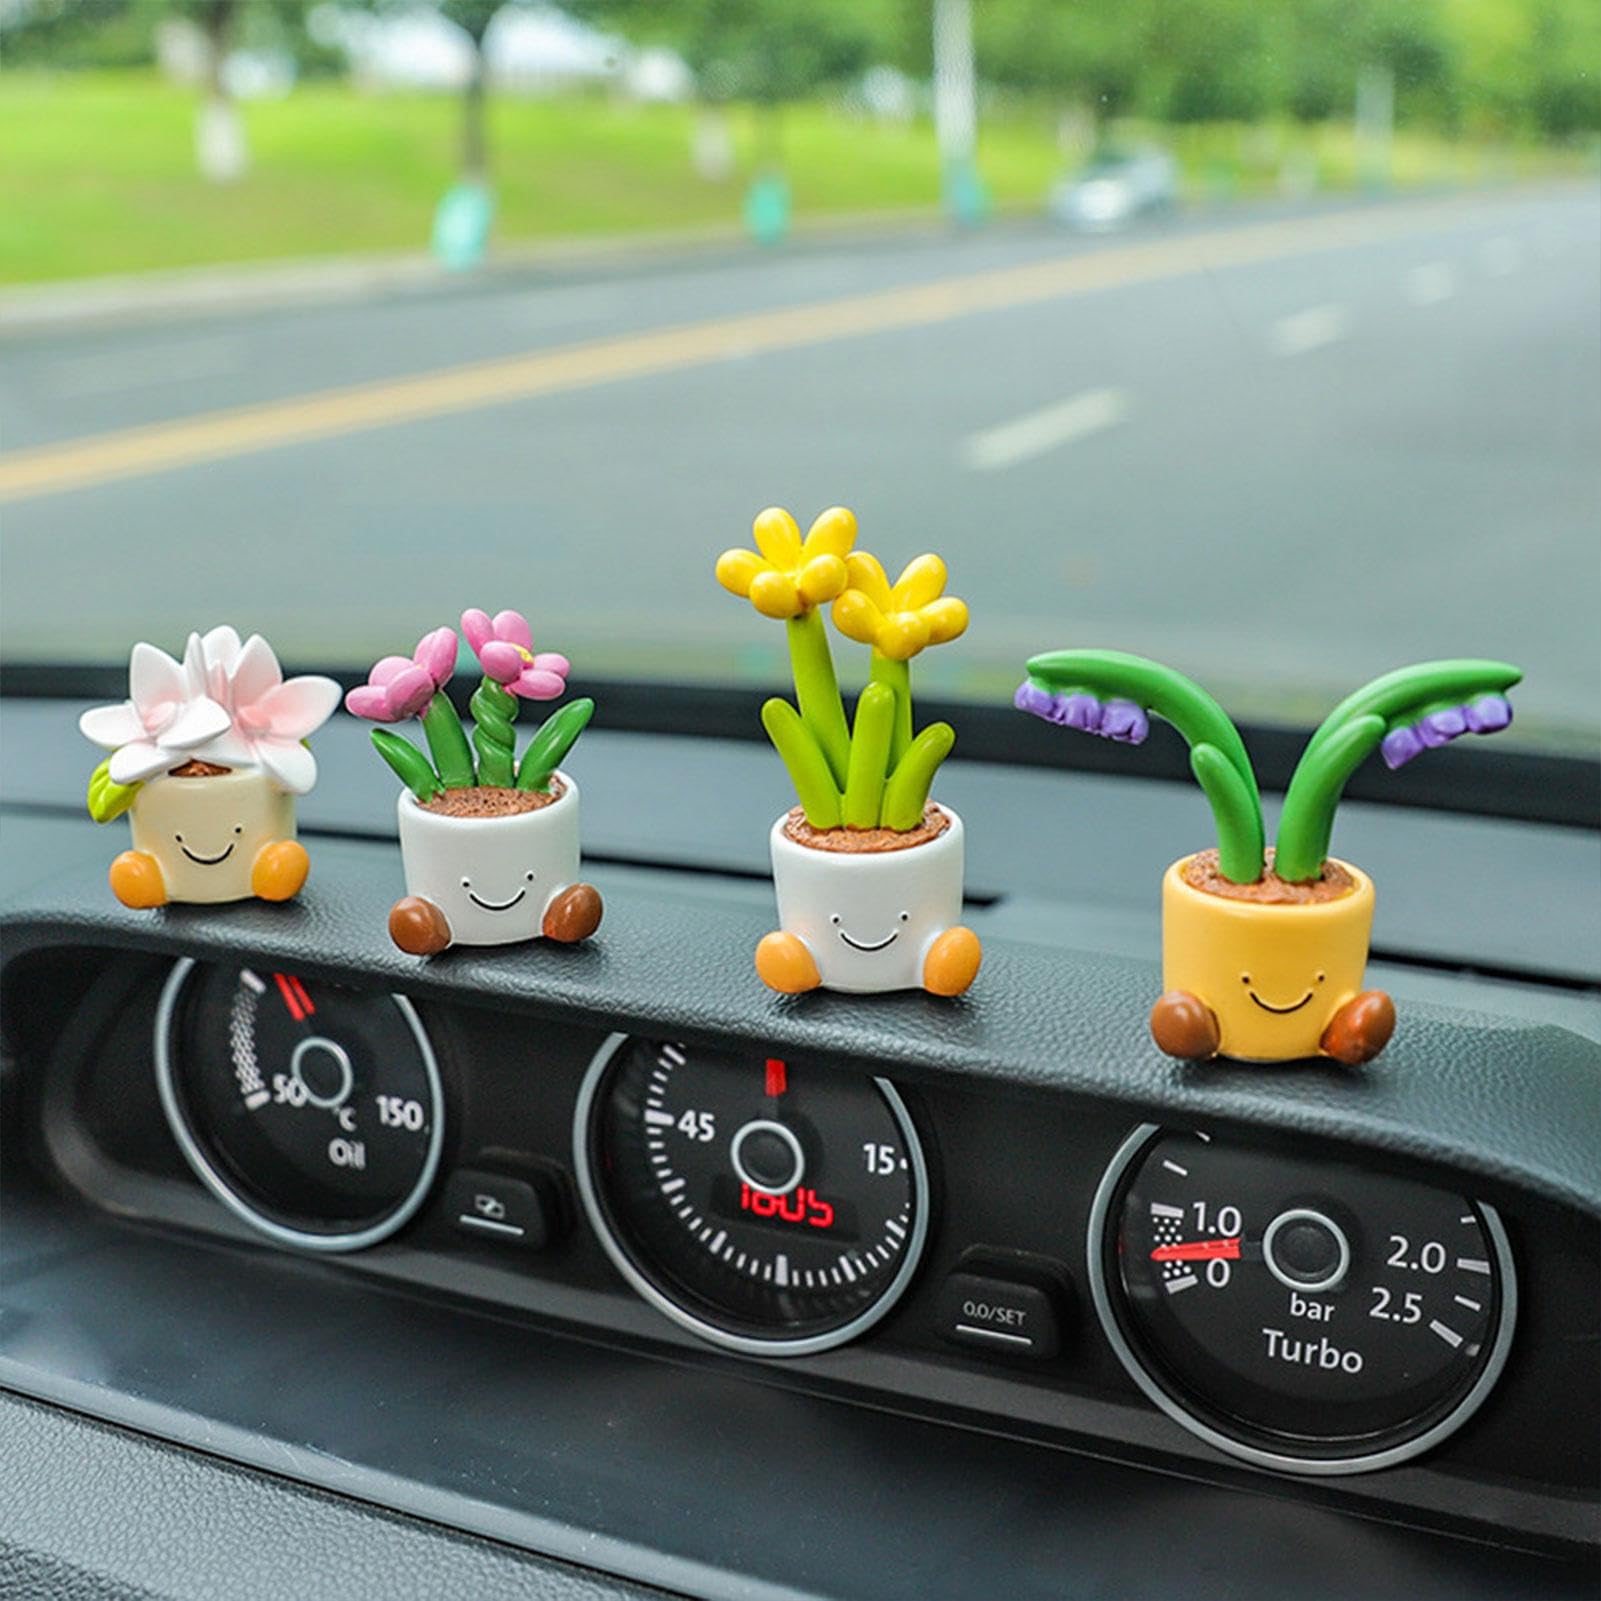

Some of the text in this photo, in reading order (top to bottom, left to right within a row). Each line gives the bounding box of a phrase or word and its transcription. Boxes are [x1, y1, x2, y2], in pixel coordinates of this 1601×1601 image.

[272, 1074, 307, 1107] 50
[375, 1095, 424, 1131] 150
[677, 1109, 715, 1142] 45
[328, 1138, 366, 1170] Oil
[863, 1142, 896, 1175] 15
[1192, 1201, 1242, 1237] 1.0
[1387, 1235, 1446, 1274] 2.0
[1206, 1257, 1231, 1288] 0
[1290, 1292, 1335, 1322] bar
[1369, 1286, 1423, 1324] 2.5
[1262, 1328, 1363, 1374] Turbo
